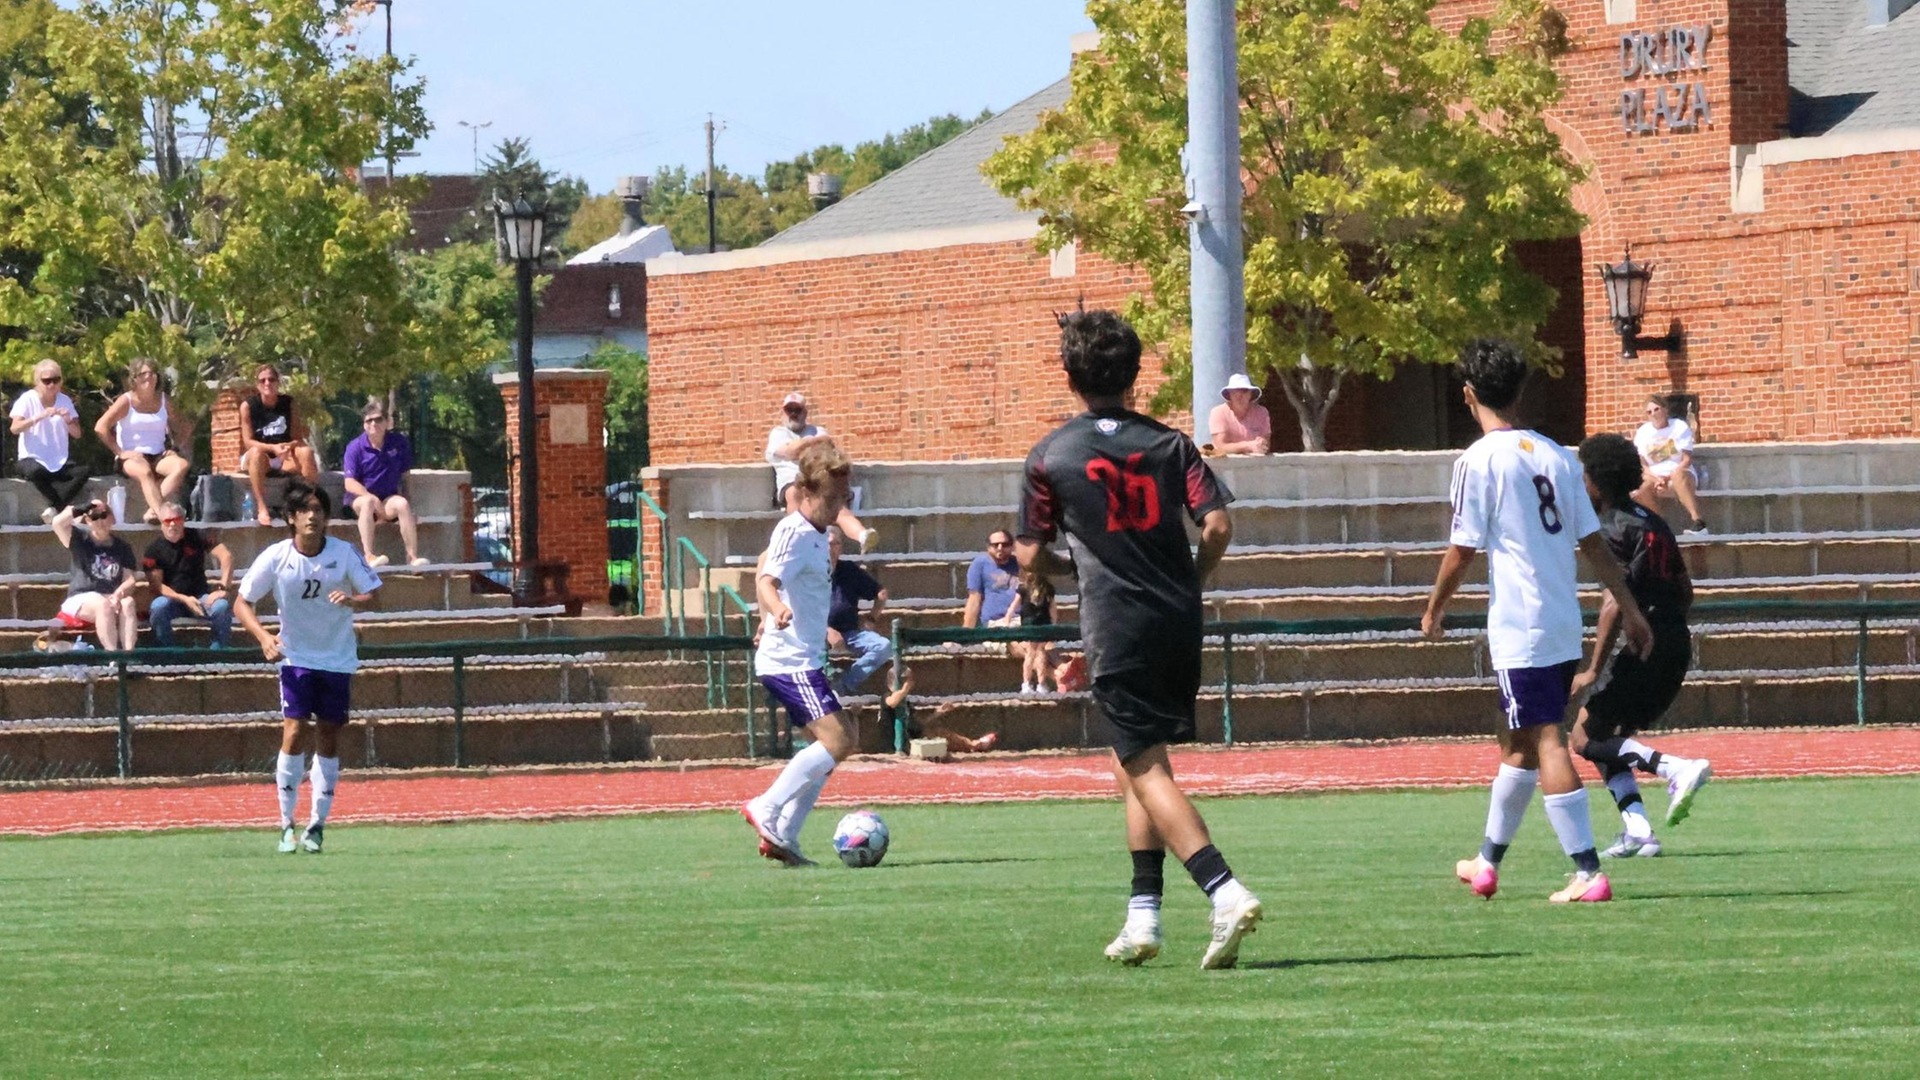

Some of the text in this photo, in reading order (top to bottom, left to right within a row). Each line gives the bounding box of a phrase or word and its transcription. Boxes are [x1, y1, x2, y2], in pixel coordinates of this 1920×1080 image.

[1621, 25, 1711, 77] DRURY
[1621, 82, 1711, 132] PLAZA
[1085, 451, 1161, 533] 26
[1532, 473, 1563, 535] 8
[301, 578, 321, 600] 22
